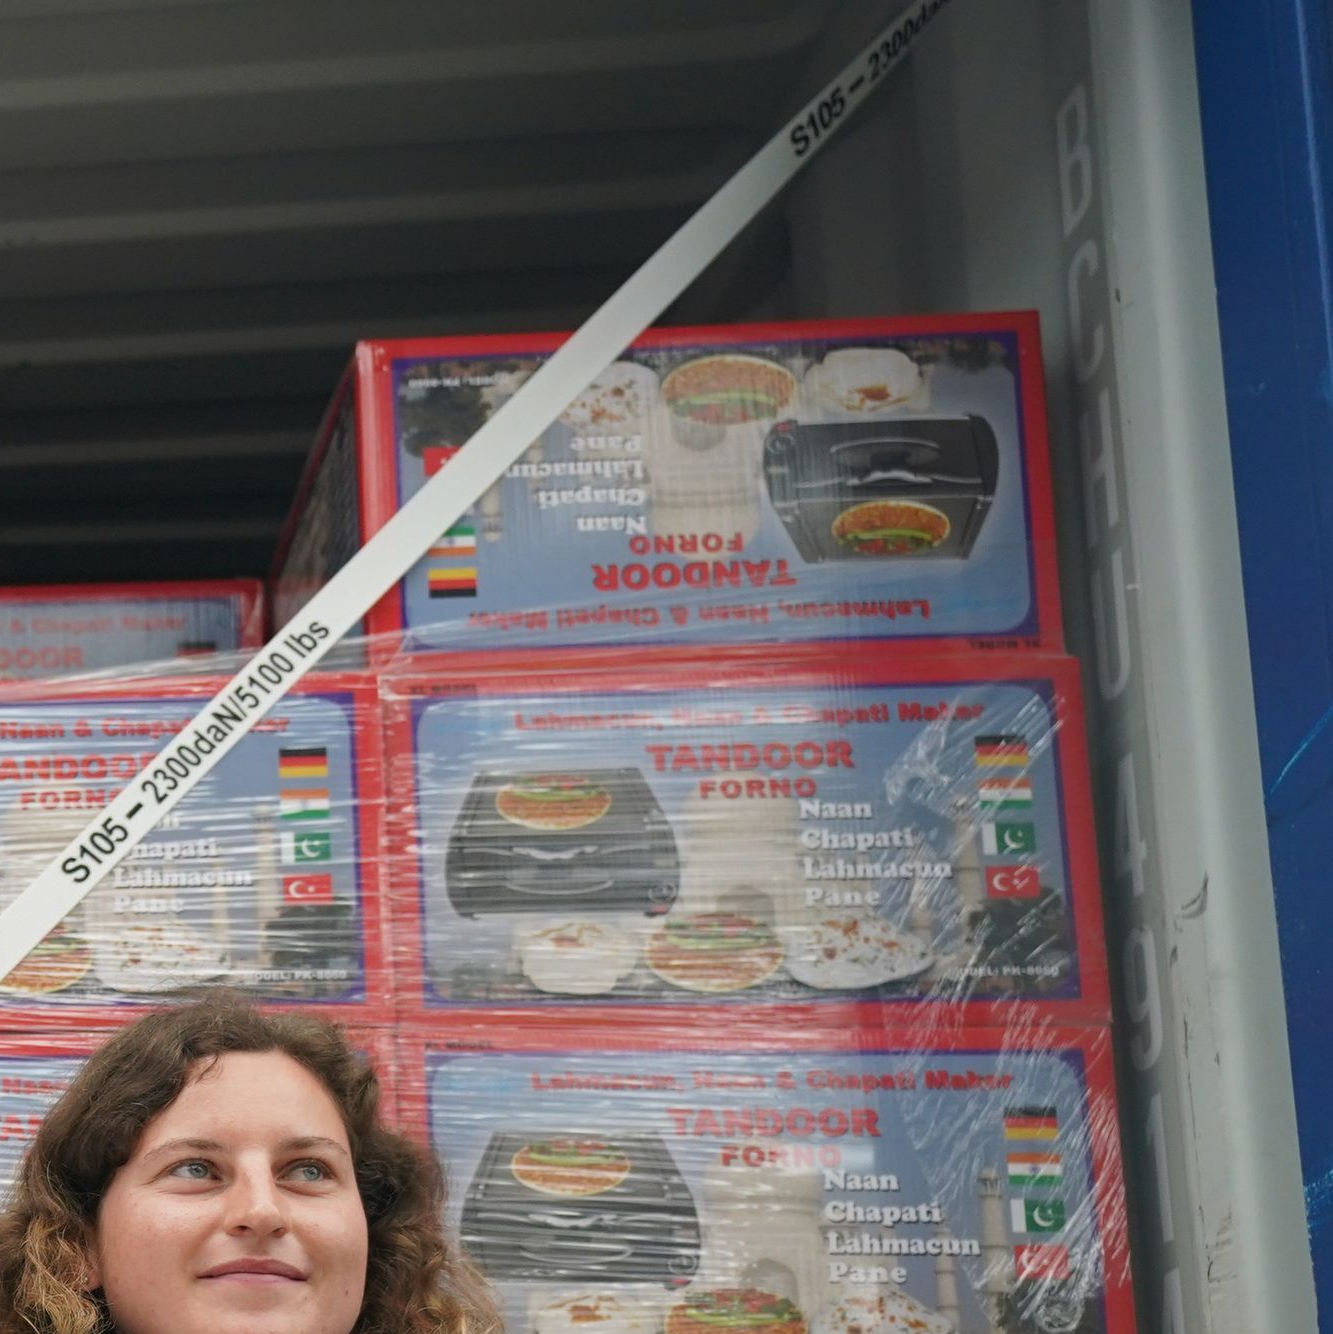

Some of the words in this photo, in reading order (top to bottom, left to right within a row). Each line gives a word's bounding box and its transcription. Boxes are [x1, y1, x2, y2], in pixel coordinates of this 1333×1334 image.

[790, 87, 846, 157] S105
[570, 434, 643, 452] Pane
[534, 486, 646, 510] Chapati
[576, 515, 648, 537] Naan
[628, 532, 744, 556] FORNO
[592, 558, 797, 593] TANDOOR
[72, 719, 92, 739] &
[61, 816, 130, 885] S105
[139, 650, 298, 807] 2300daN/5100
[289, 618, 331, 662] lbs
[645, 739, 856, 773] TANDOOR
[698, 777, 818, 800] FORNO
[798, 799, 874, 820] Naan
[798, 827, 916, 852] Chapati
[804, 887, 882, 908] Pane
[805, 1070, 917, 1094] Chapati
[922, 1069, 1015, 1091] Maker
[665, 1107, 882, 1139] TANDOOR
[719, 1144, 842, 1169] FORNO
[823, 1170, 900, 1192] Naan
[824, 1200, 943, 1227] Chapati
[827, 1230, 982, 1257] Lahmacun
[827, 1262, 908, 1284] Pane
